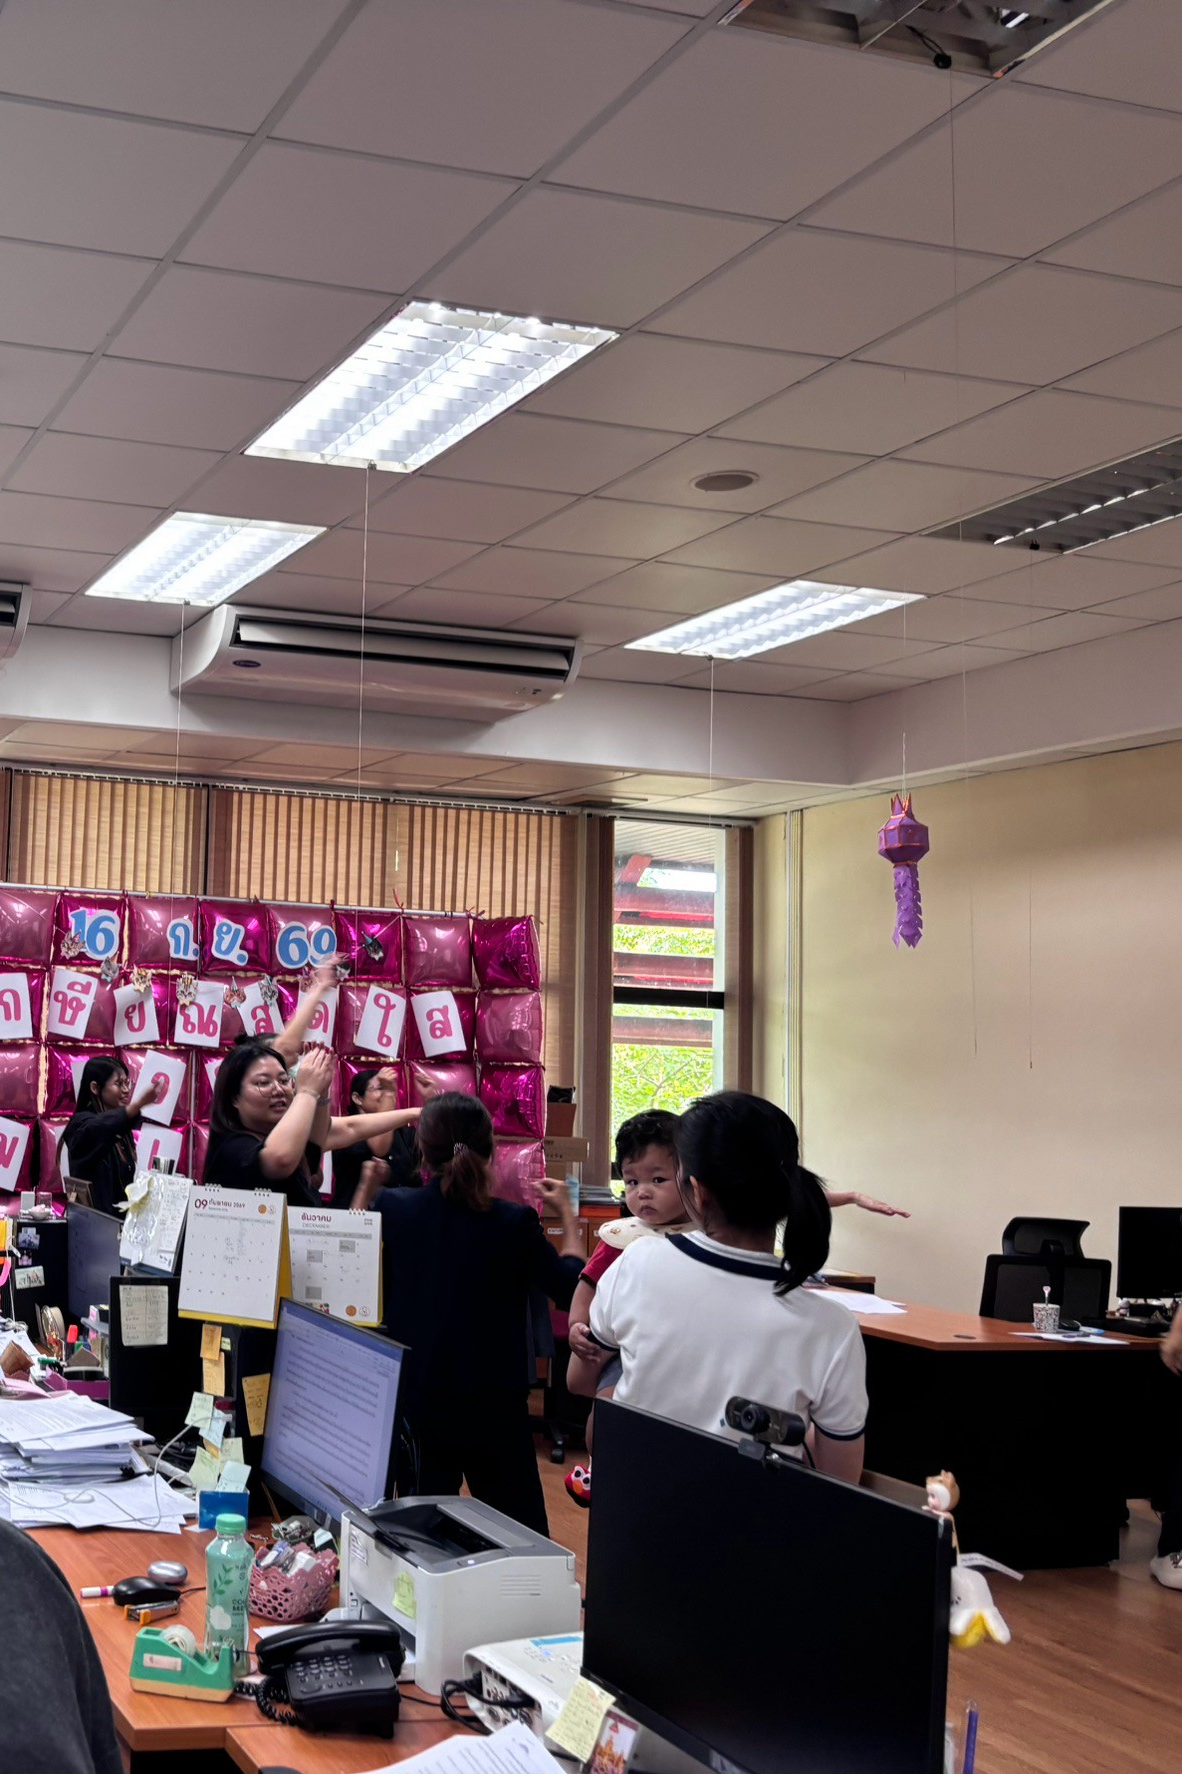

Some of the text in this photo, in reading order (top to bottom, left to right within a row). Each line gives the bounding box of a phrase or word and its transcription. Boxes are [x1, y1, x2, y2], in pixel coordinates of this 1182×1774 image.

[70, 909, 116, 956] 16
[278, 925, 336, 967] 69
[194, 1198, 208, 1210] 09
[301, 1212, 332, 1222] ธันวาคม
